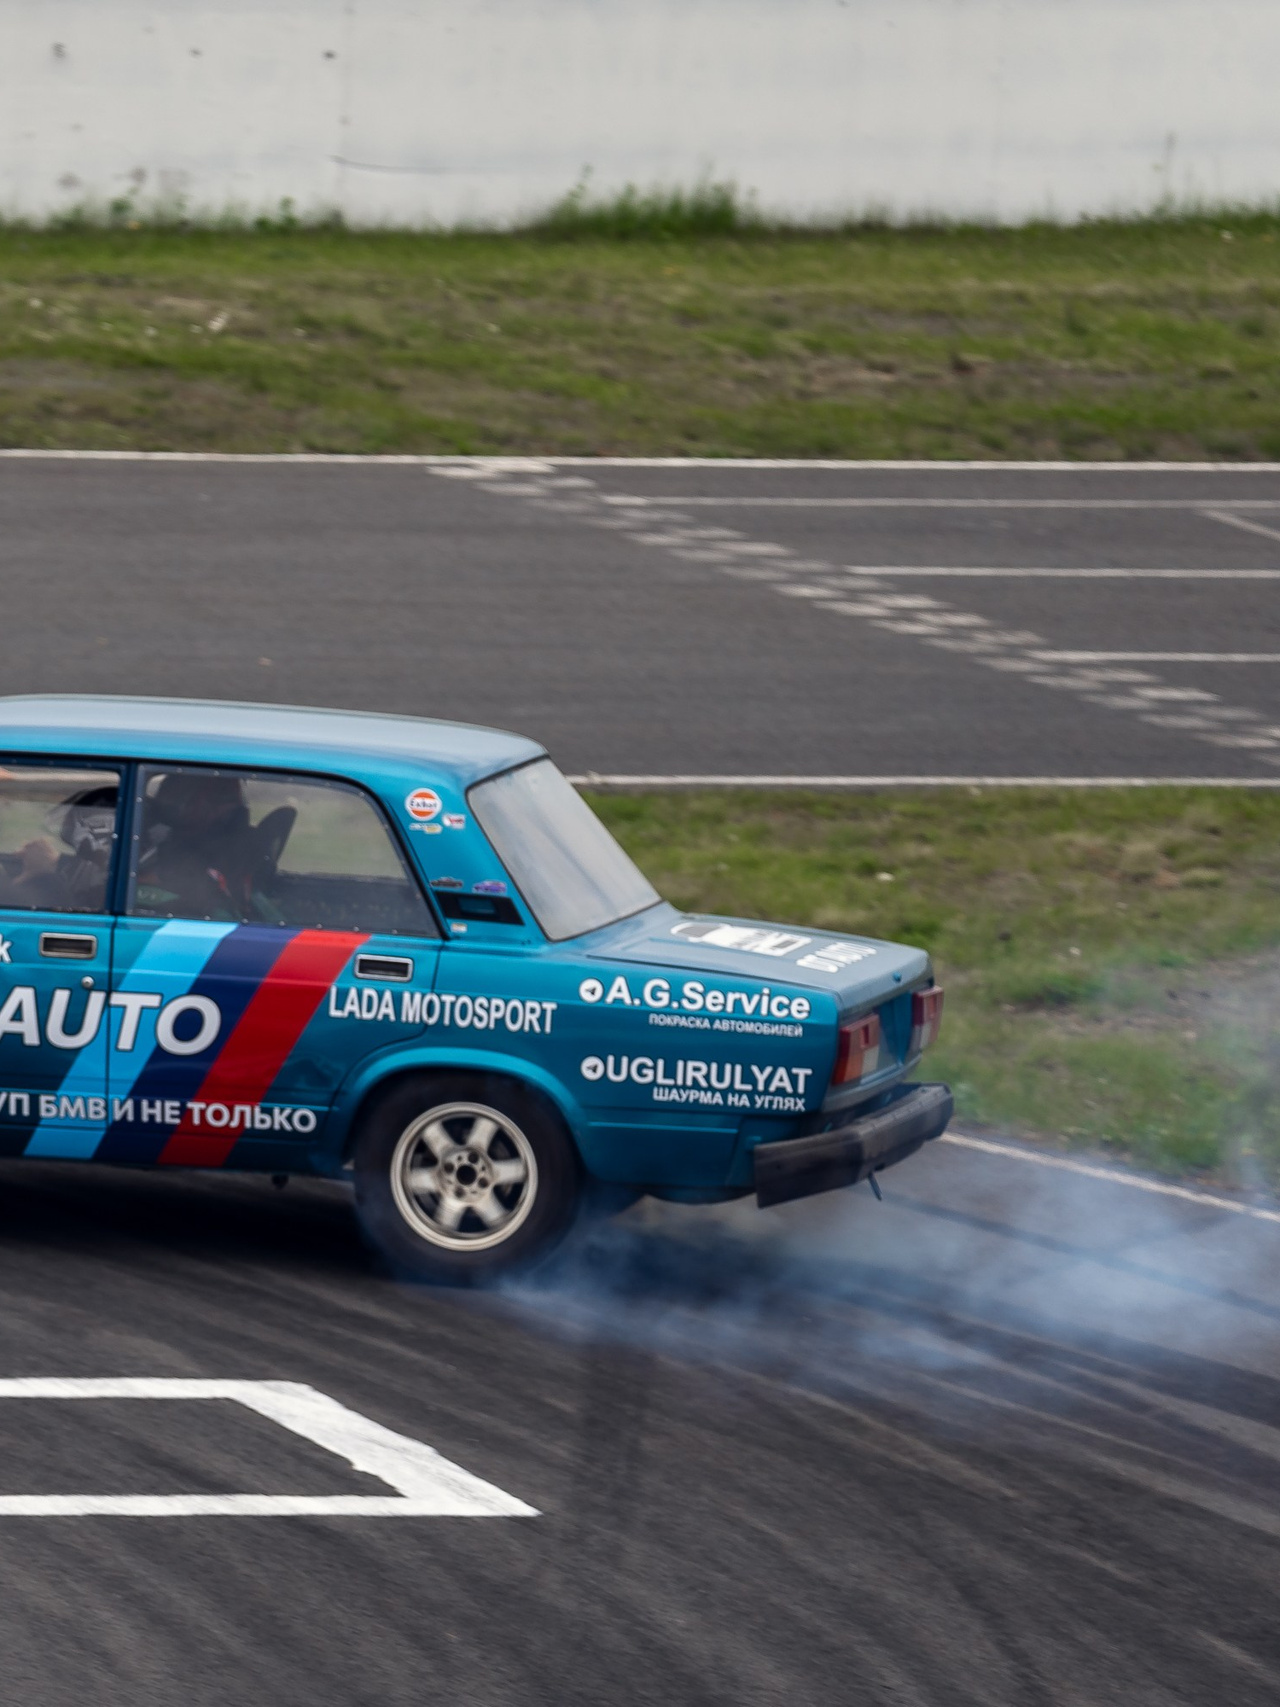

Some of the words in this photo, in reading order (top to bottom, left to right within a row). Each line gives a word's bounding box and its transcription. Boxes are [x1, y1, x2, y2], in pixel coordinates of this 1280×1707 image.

[329, 985, 395, 1021] LADA
[400, 991, 557, 1034] MOTOSPORT
[648, 1013, 711, 1030] ПОКРАСКА
[713, 1019, 803, 1038] АВТОМОБИЛЕЙ
[605, 1055, 813, 1094] UGLIRULYAT
[38, 1094, 107, 1121] БМВ
[113, 1098, 134, 1122] И
[141, 1099, 181, 1124] НЕ
[186, 1102, 317, 1133] ТОЛЬКО
[653, 1086, 723, 1105] ШАУРМА
[727, 1093, 750, 1107] НА
[754, 1095, 806, 1112] УГЛЯХ
